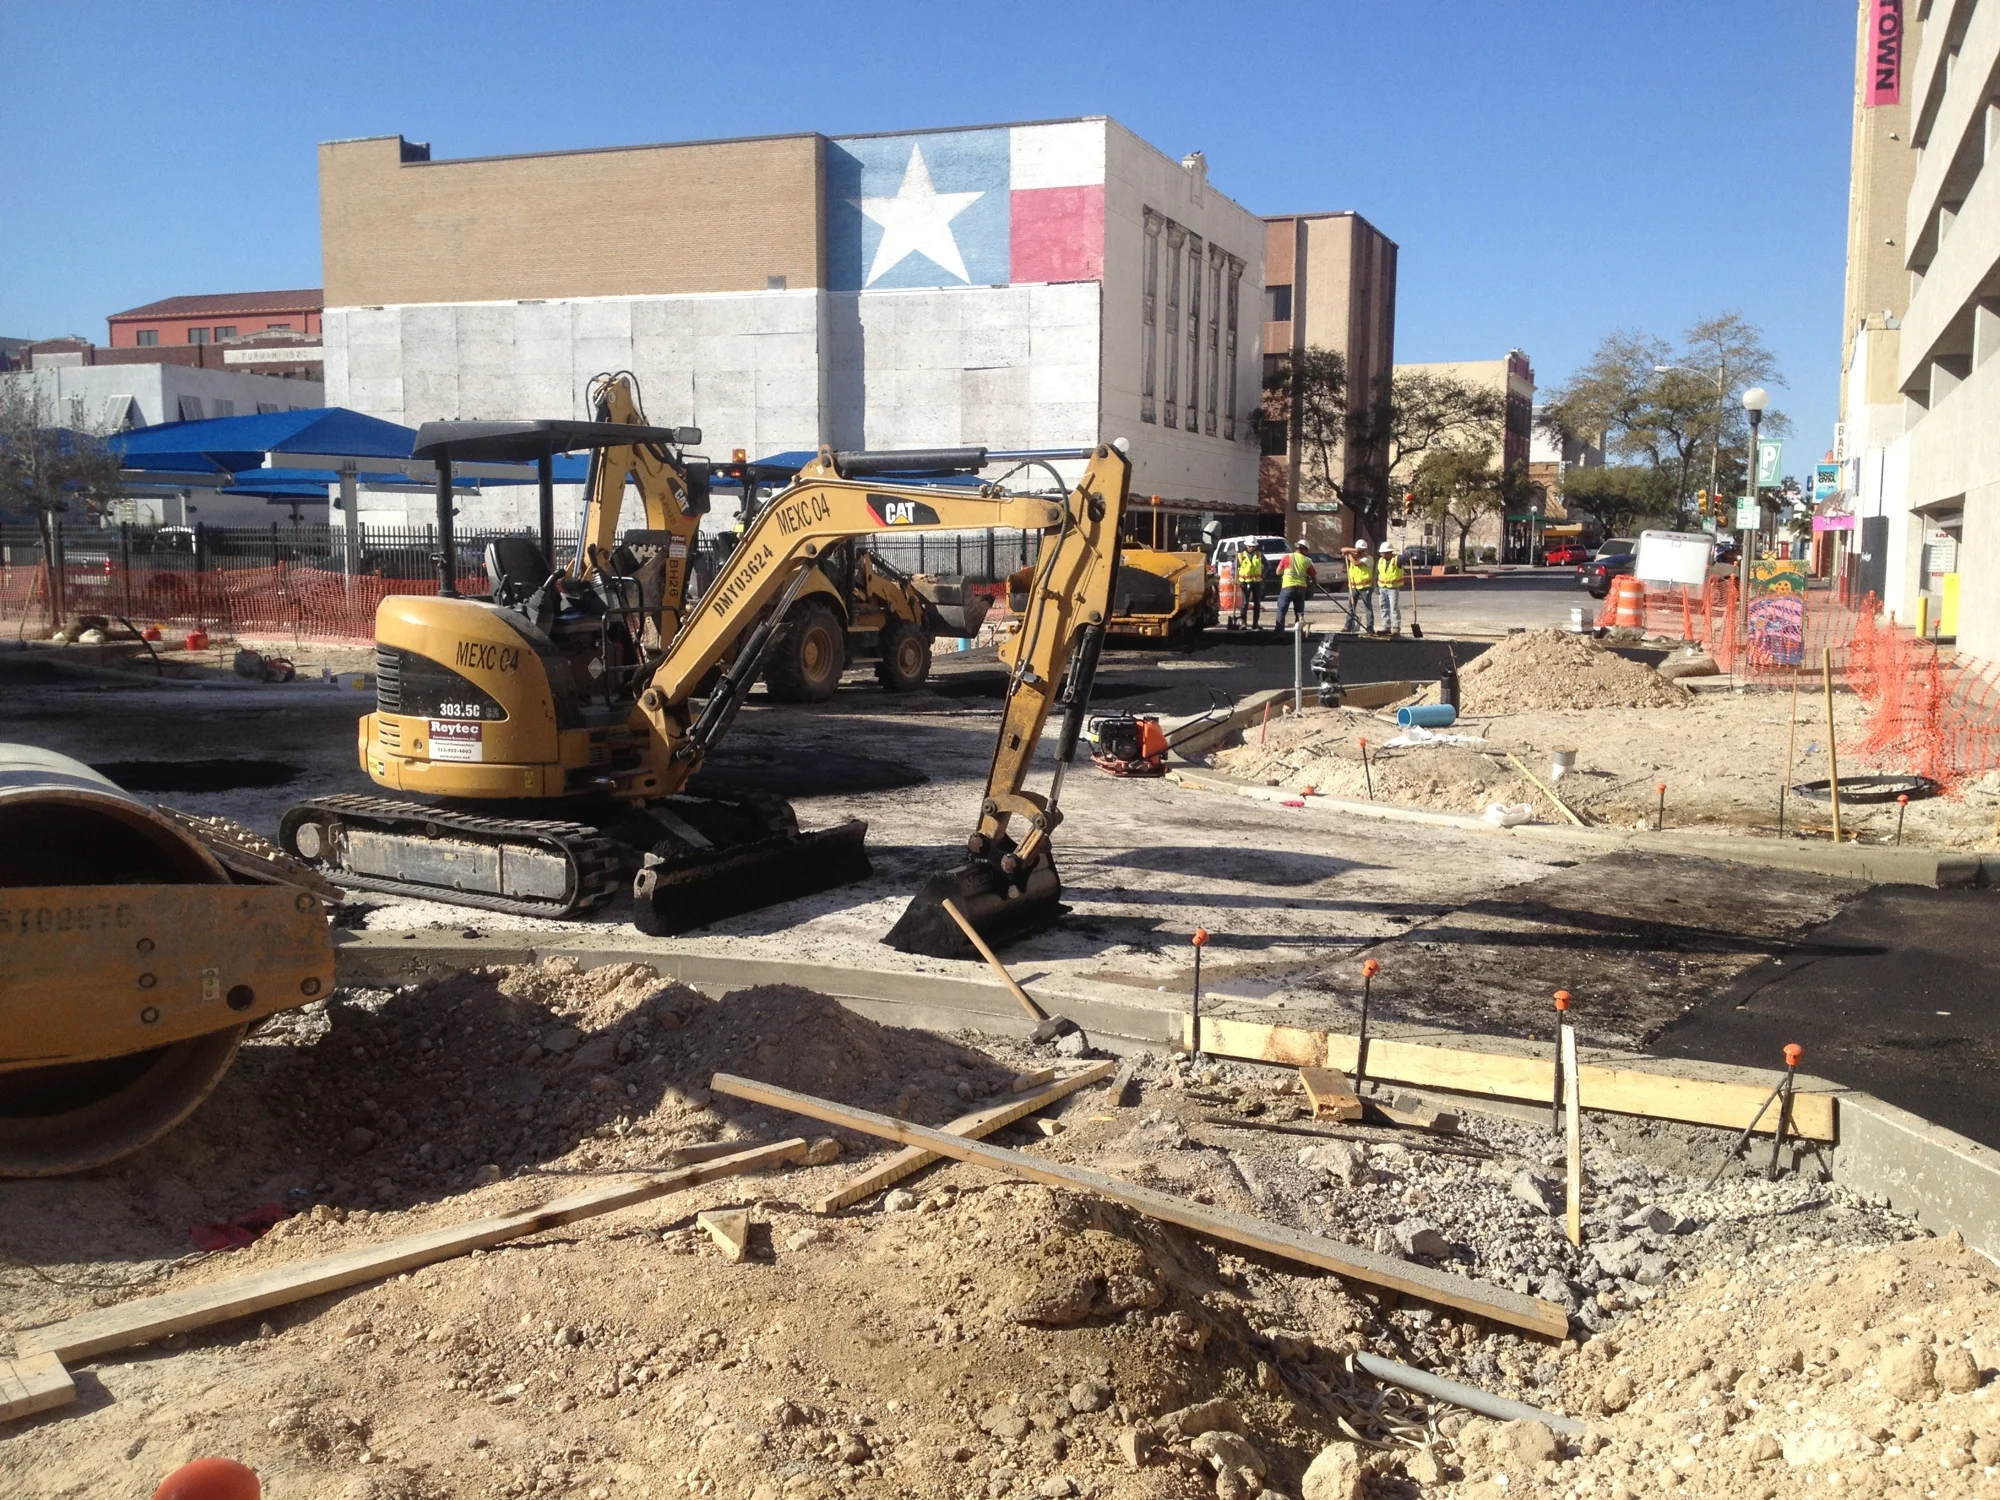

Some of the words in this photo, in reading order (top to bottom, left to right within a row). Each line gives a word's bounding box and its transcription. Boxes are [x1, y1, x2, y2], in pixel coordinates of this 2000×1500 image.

[1763, 446, 1776, 468] P
[674, 488, 689, 512] CAT
[885, 502, 915, 524] CAT
[776, 502, 812, 536] MEXC
[812, 493, 830, 522] 04
[669, 560, 679, 597] BH26
[712, 544, 774, 618] DMY03624
[456, 641, 497, 670] MEXC
[431, 721, 479, 736] Reytec
